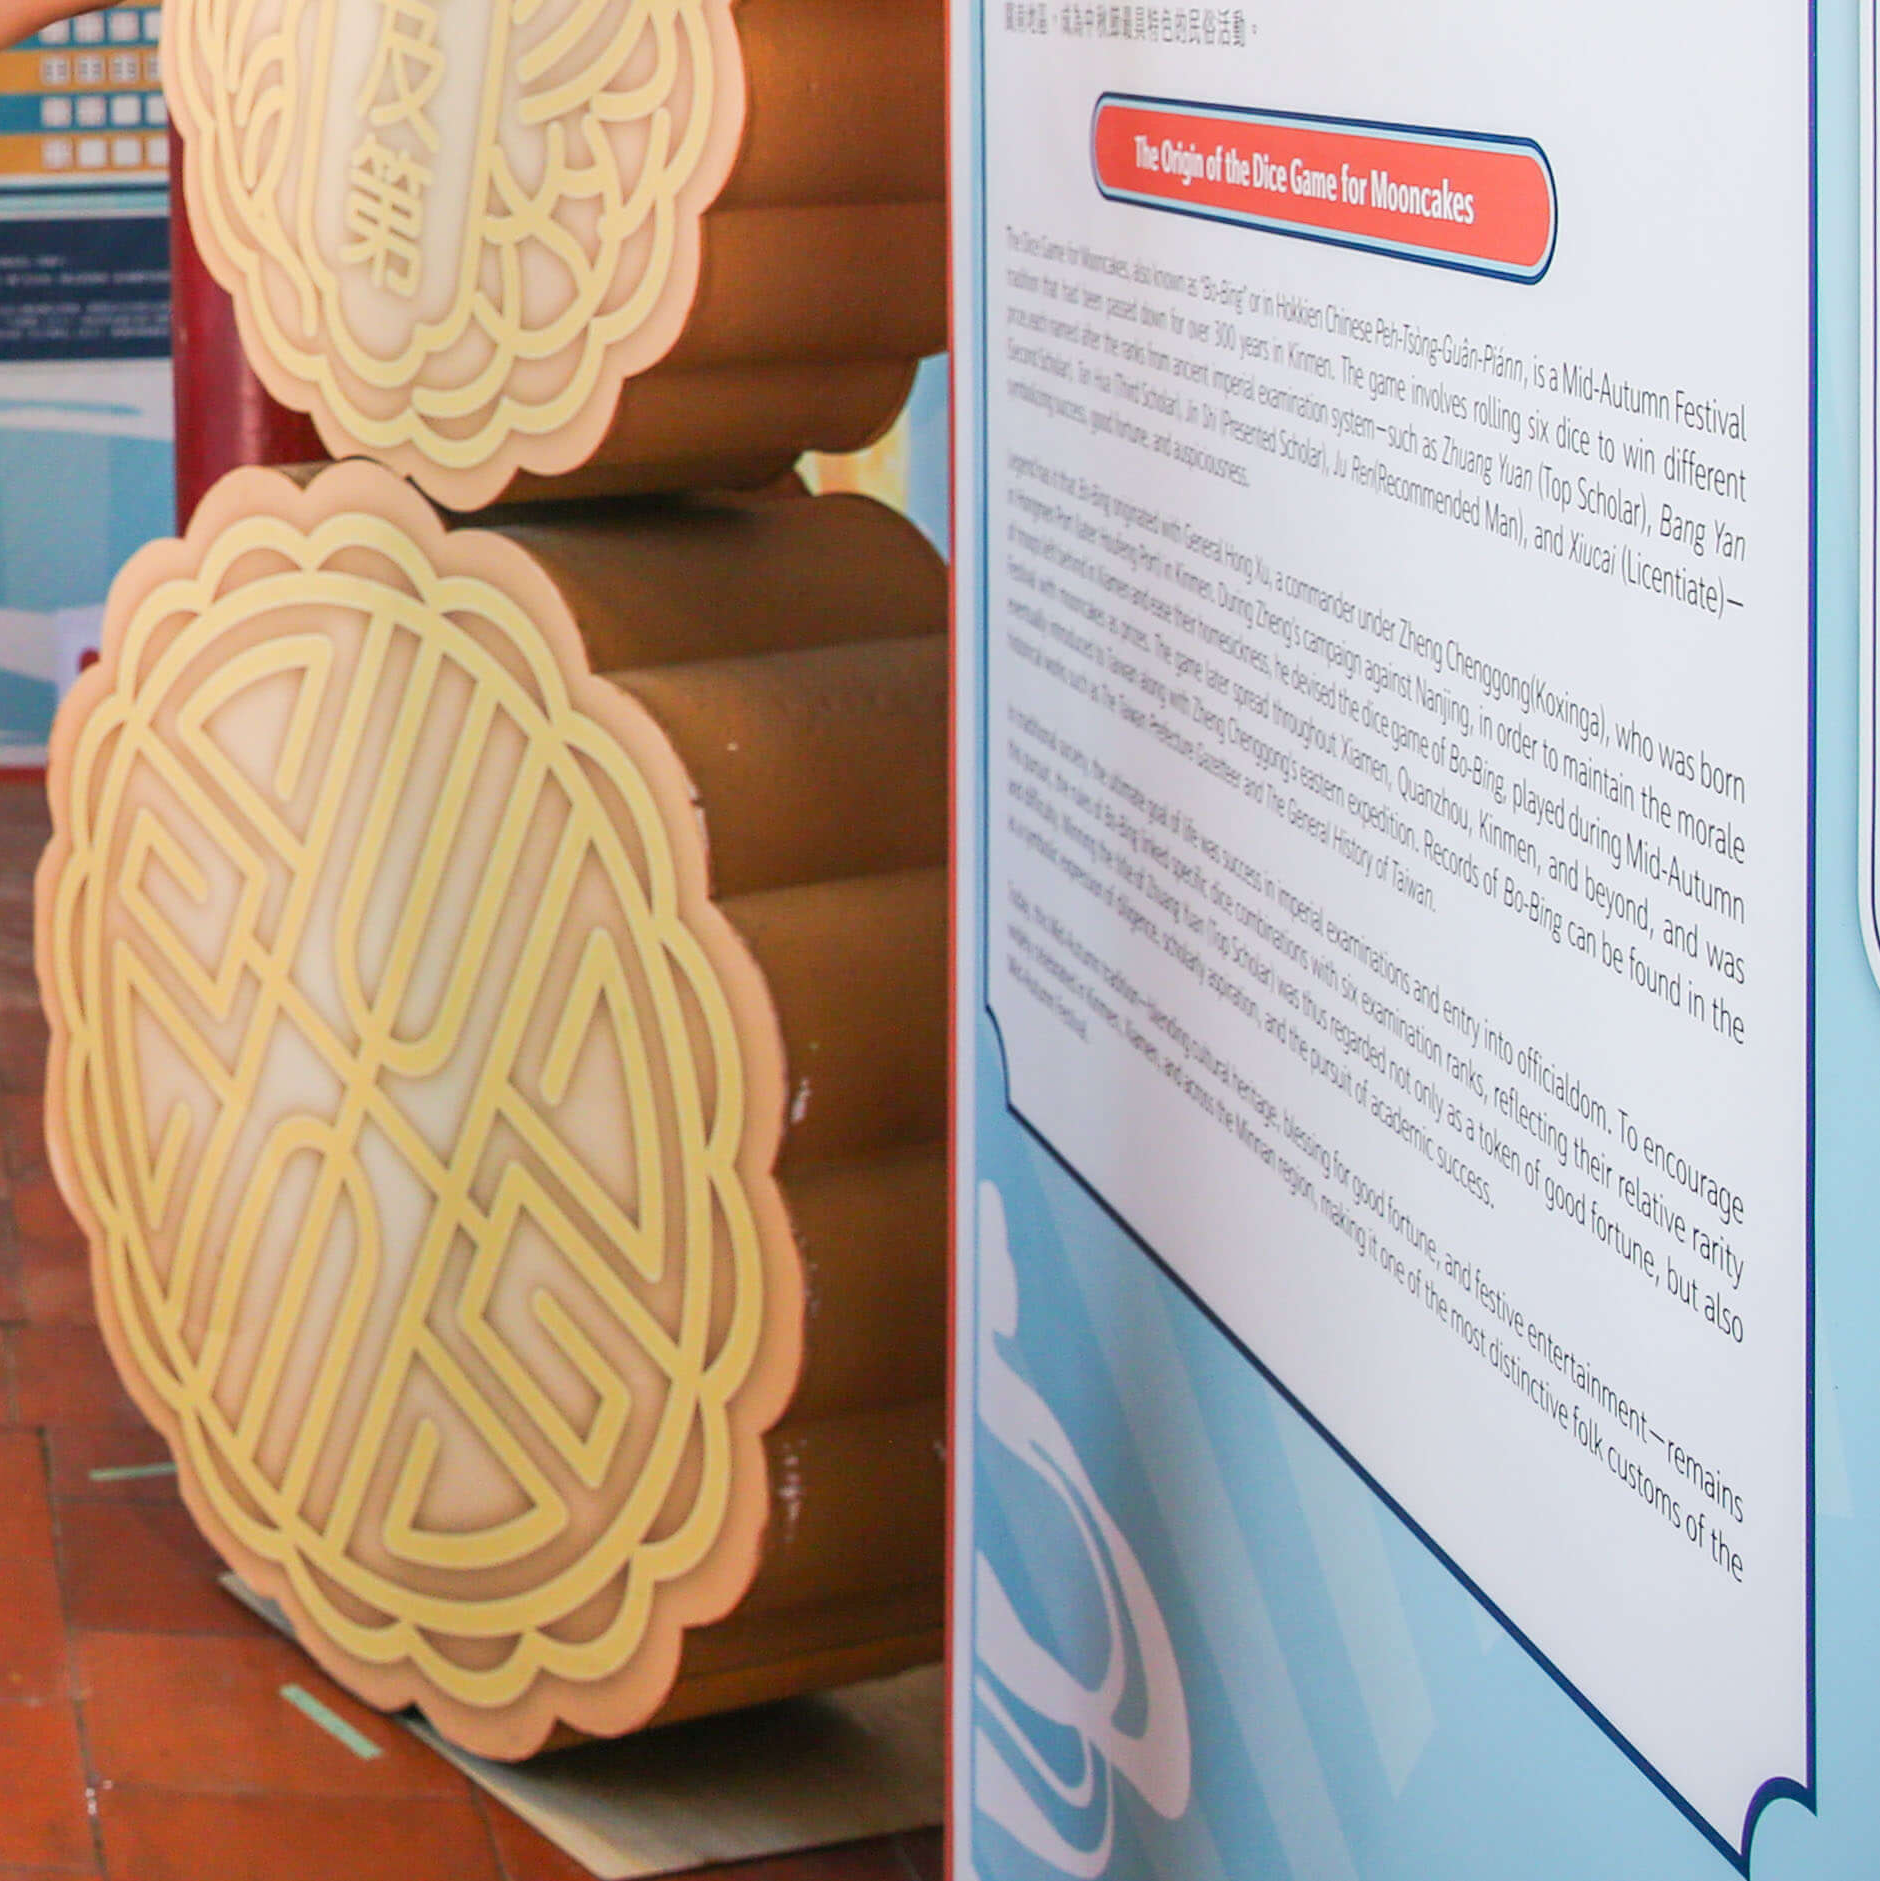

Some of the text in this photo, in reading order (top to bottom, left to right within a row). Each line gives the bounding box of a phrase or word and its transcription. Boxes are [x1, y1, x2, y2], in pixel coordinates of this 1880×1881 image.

[1134, 135, 1475, 225] The Origin of the Dice Game for Mooncakes
[1324, 303, 1374, 346] Chinese
[1532, 354, 1546, 391] is
[1548, 367, 1560, 394] a
[1561, 362, 1671, 422] Mid-Autumn
[1674, 389, 1748, 443] Festival
[1340, 354, 1747, 504] The game involves rolling six dice to win different
[1331, 449, 1348, 480] Ju
[1484, 498, 1529, 551] Man),
[1532, 524, 1565, 559] and
[1567, 529, 1618, 577] Xiucai
[1421, 435, 1439, 464] as
[1440, 434, 1494, 488] Zhuang
[1497, 452, 1534, 493] Yuan
[1537, 461, 1573, 515] (Top
[1576, 475, 1653, 539] Scholar),
[1658, 502, 1707, 559] Bang
[1713, 519, 1747, 563] Yan
[1356, 608, 1746, 806] under Zheng Chenggong(Koxinga), who was born
[1363, 658, 1746, 866] against Nanjing, in order to maintain the morale
[1331, 824, 1437, 914] History of Taiwan.
[1337, 687, 1746, 926] the dice game of Bo-Bing, played during Mid-Autumn
[1340, 734, 1746, 986] Xiamen, Quanzhou, Kinmen, and beyond, and was
[1346, 792, 1746, 1047] expedition. Records of Bo-Bing can be found in the
[1329, 1015, 1745, 1345] regarded not only as a token of good fortune, but also
[1340, 972, 1745, 1292] six examination ranks, reflecting their relative rarity
[1353, 1078, 1495, 1210] of academic success.
[1412, 978, 1441, 1017] and
[1442, 998, 1482, 1050] entry
[1483, 1018, 1515, 1067] into
[1516, 1046, 1613, 1136] officialdom.
[1616, 1107, 1639, 1154] To
[1642, 1136, 1745, 1227] encourage
[1332, 1148, 1352, 1188] for
[1351, 1174, 1386, 1219] good
[1386, 1195, 1441, 1272] fortune,
[1443, 1252, 1473, 1294] and
[1474, 1267, 1525, 1340] festive
[1367, 1226, 1745, 1585] it one of the most distinctive folk customs of the
